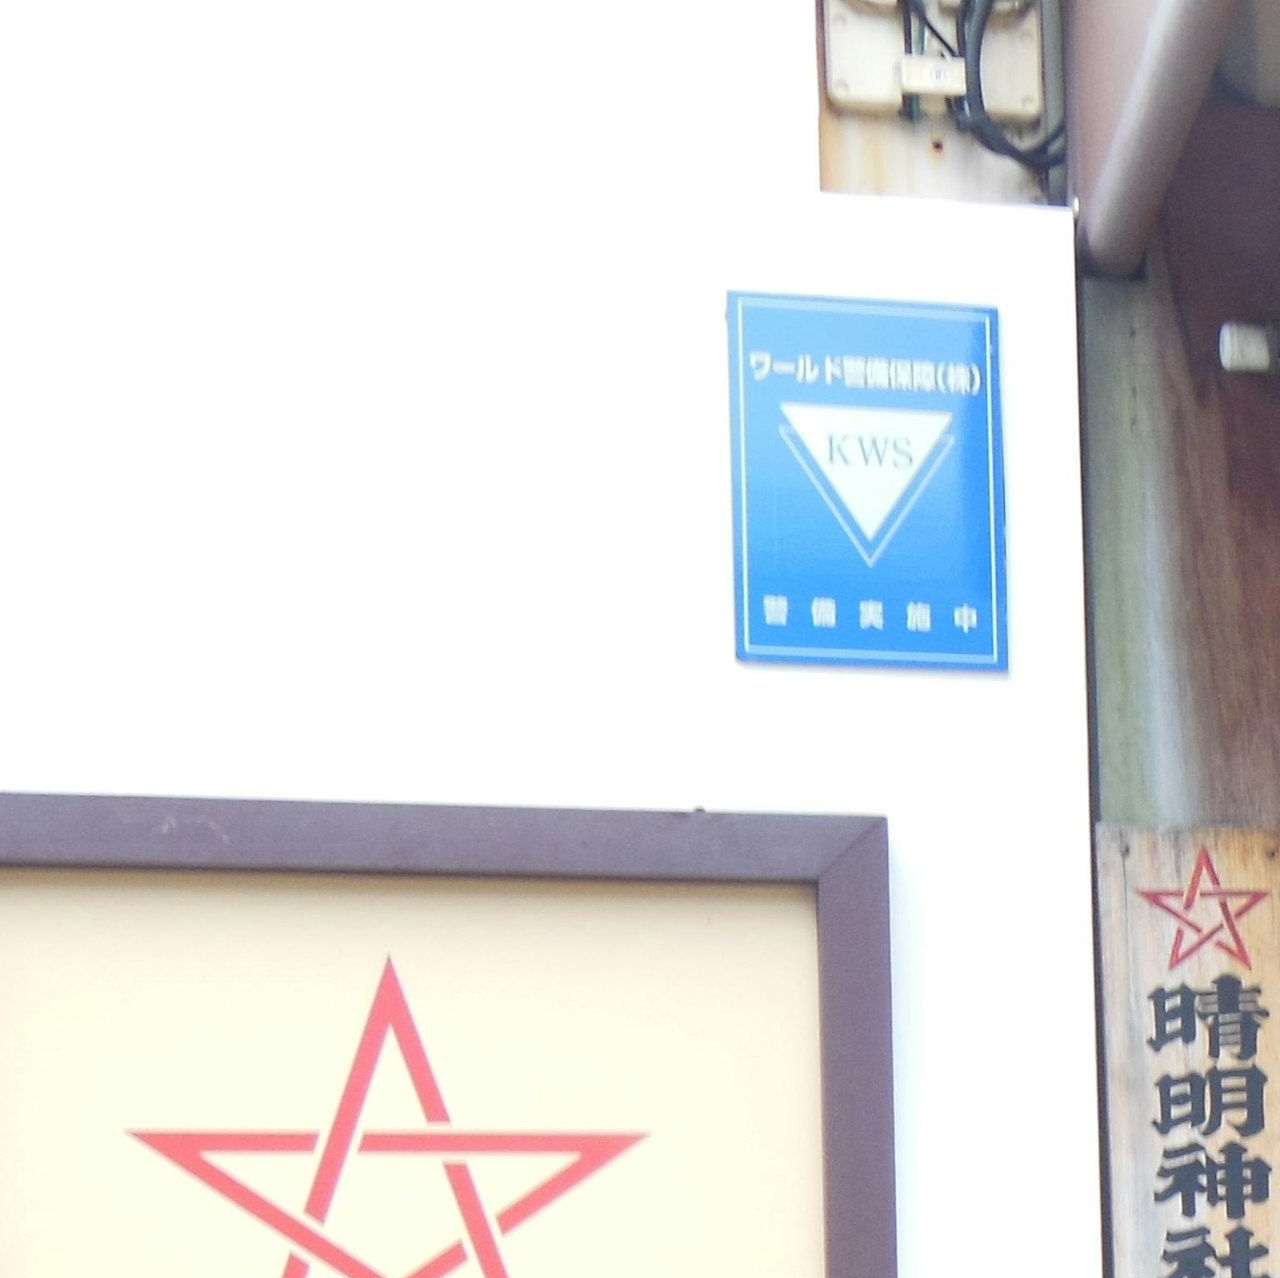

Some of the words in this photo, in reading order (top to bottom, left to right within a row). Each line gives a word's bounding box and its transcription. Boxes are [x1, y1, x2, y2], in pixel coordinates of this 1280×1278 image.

[826, 433, 915, 469] KWS
[762, 595, 978, 634] 警備実施中
